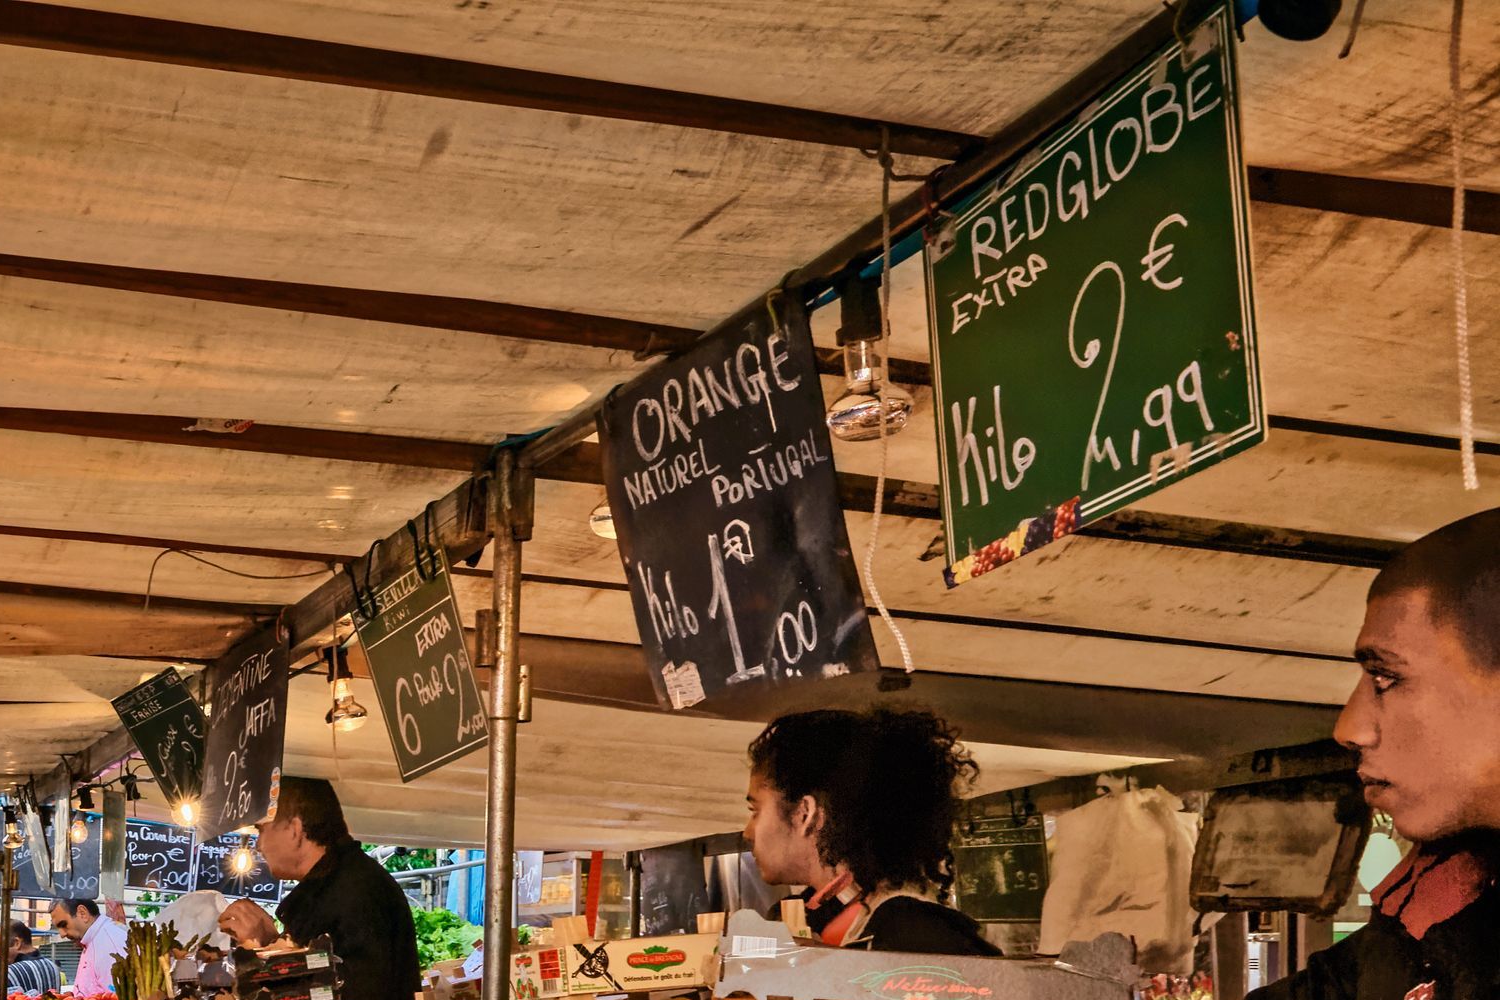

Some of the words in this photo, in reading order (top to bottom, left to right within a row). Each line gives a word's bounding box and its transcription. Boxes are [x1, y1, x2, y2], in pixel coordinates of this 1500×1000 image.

[952, 253, 1048, 334] EXTRA
[632, 329, 802, 462] ORANGE
[623, 438, 722, 510] NATUREL
[711, 428, 828, 508] PORTUGAL
[952, 385, 1036, 506] Kilo
[414, 612, 451, 658] EXTRA
[638, 561, 699, 645] Kilo
[239, 697, 277, 750] JAFFA
[396, 677, 421, 756] 6
